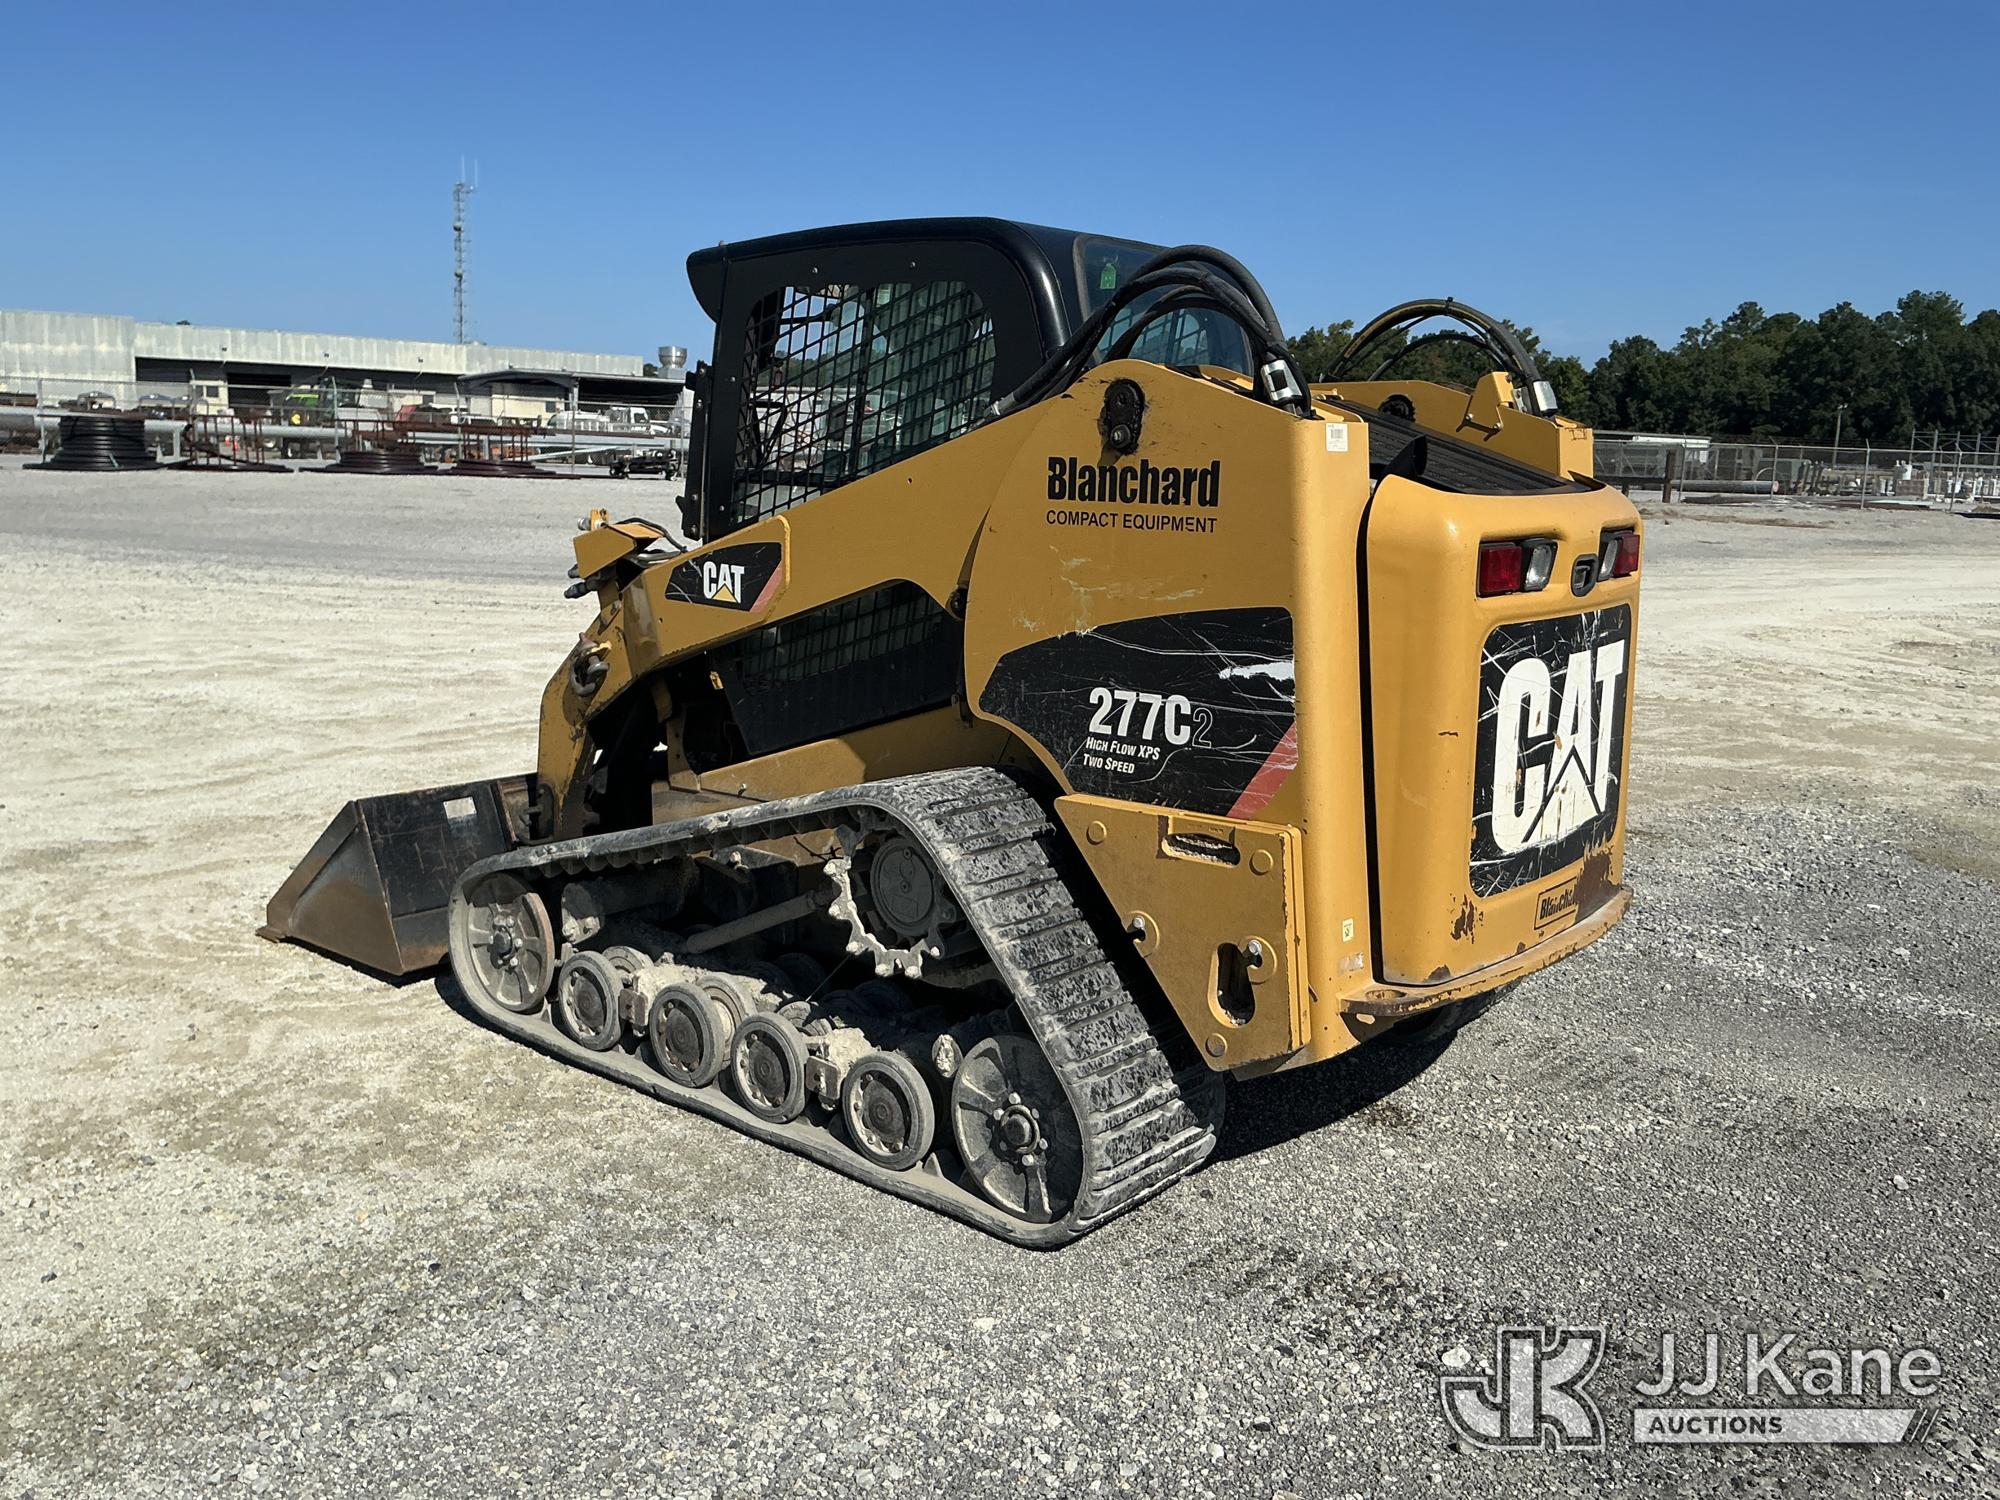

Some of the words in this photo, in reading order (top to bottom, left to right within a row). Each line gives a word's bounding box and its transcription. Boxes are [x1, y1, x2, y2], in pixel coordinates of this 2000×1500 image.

[1048, 457, 1220, 507] Blanchard
[1046, 510, 1118, 528] COMPACT
[1123, 514, 1217, 533] EQUIPMENT
[703, 561, 745, 604] CAT
[1138, 745, 1160, 760] XPS
[1491, 640, 1625, 853] CAT
